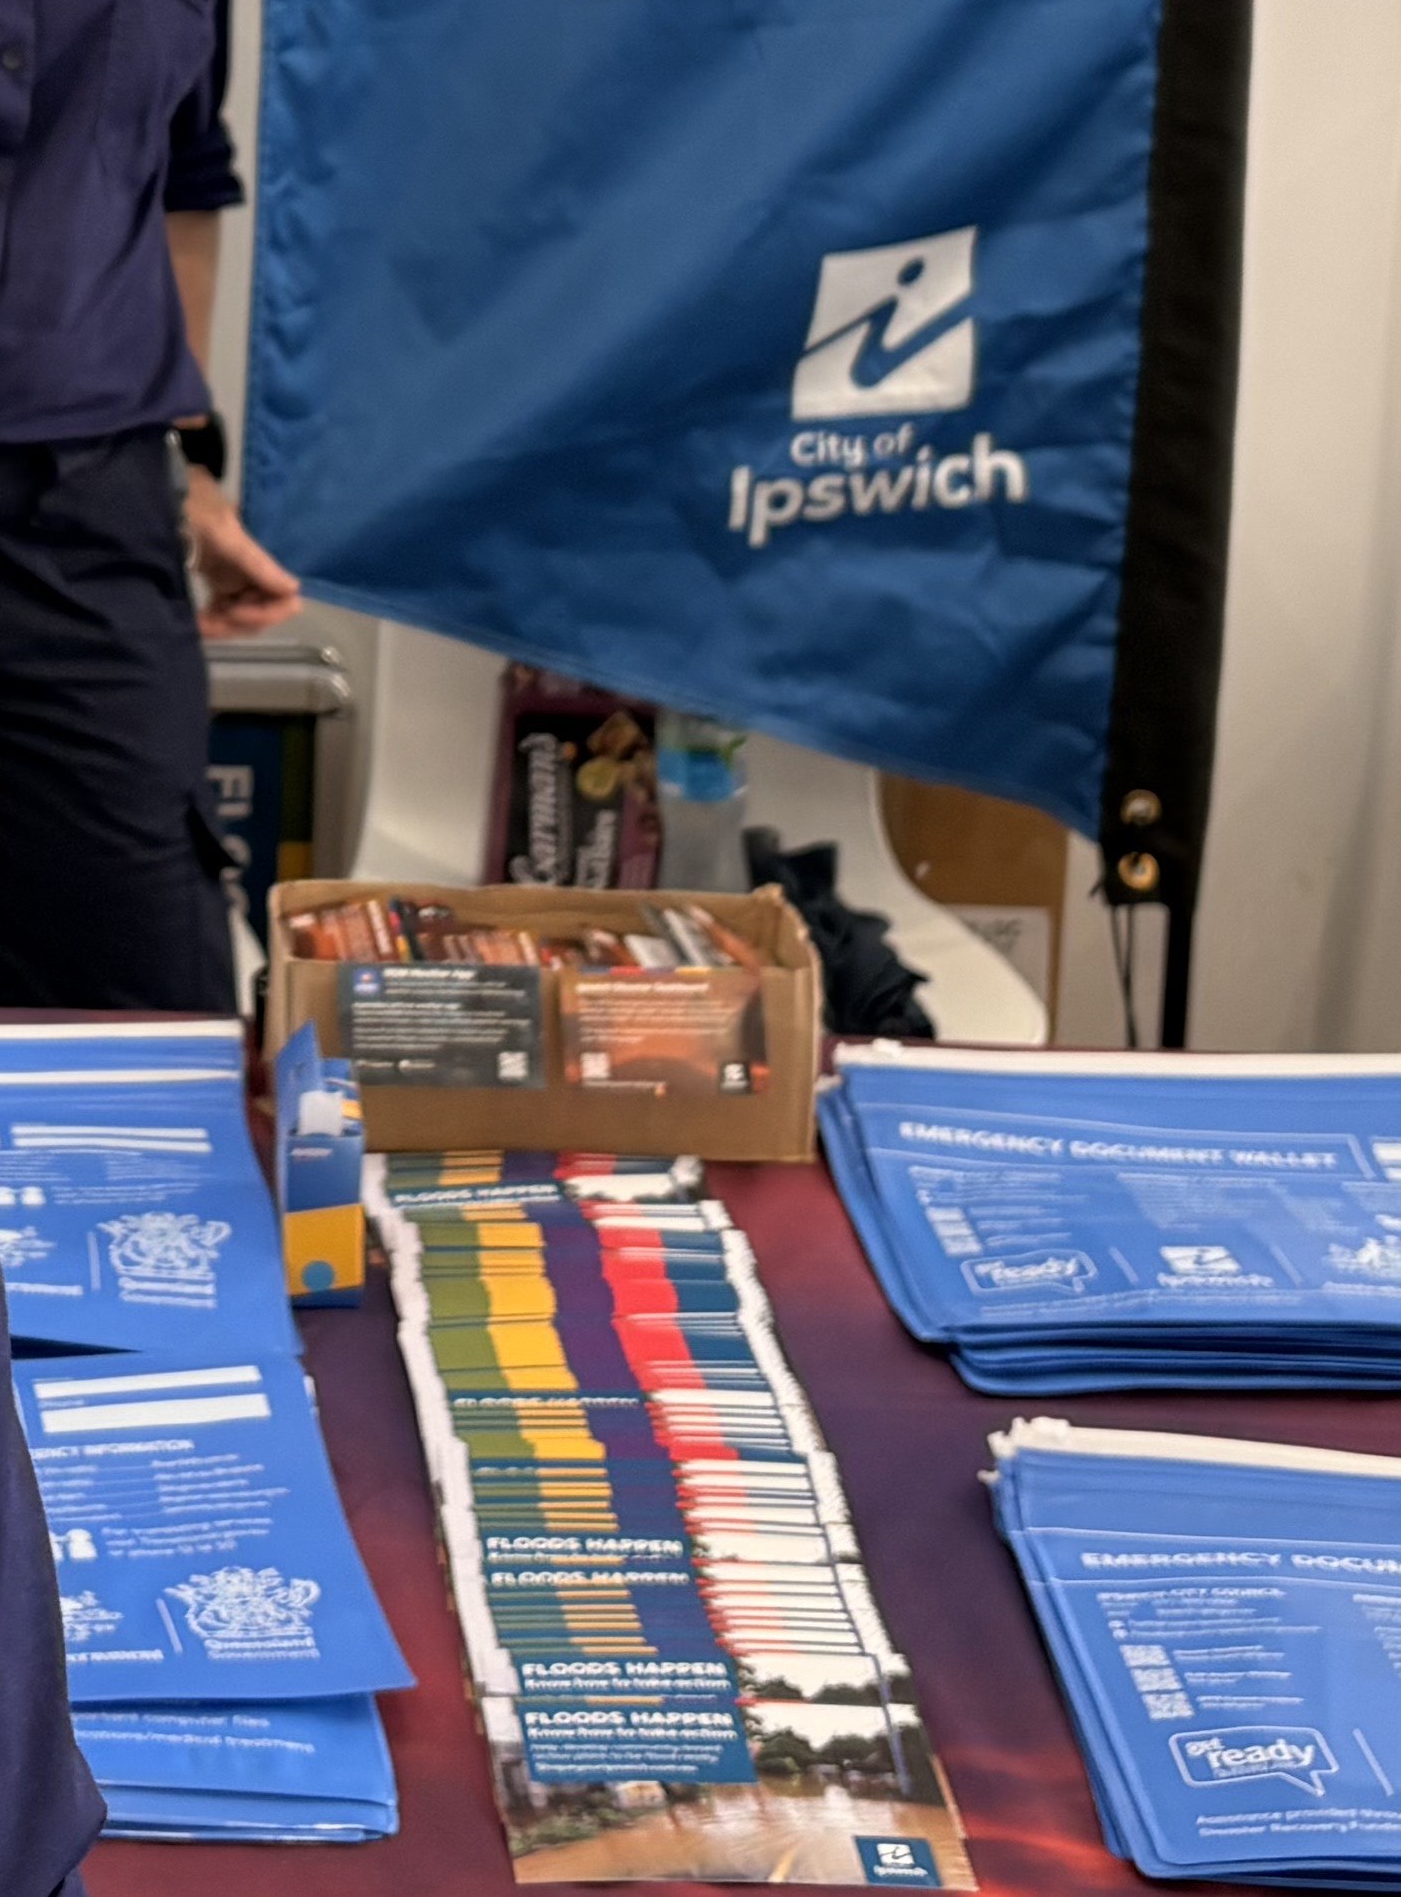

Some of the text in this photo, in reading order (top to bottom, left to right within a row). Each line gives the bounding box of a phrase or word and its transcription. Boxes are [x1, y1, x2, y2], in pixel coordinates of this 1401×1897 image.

[790, 424, 913, 469] City of
[728, 433, 1028, 549] Ipswich
[521, 1661, 728, 1678] FLOODS HAPPEN
[524, 1711, 734, 1728] FLOODS HAPPEN
[1207, 1739, 1316, 1771] ready
